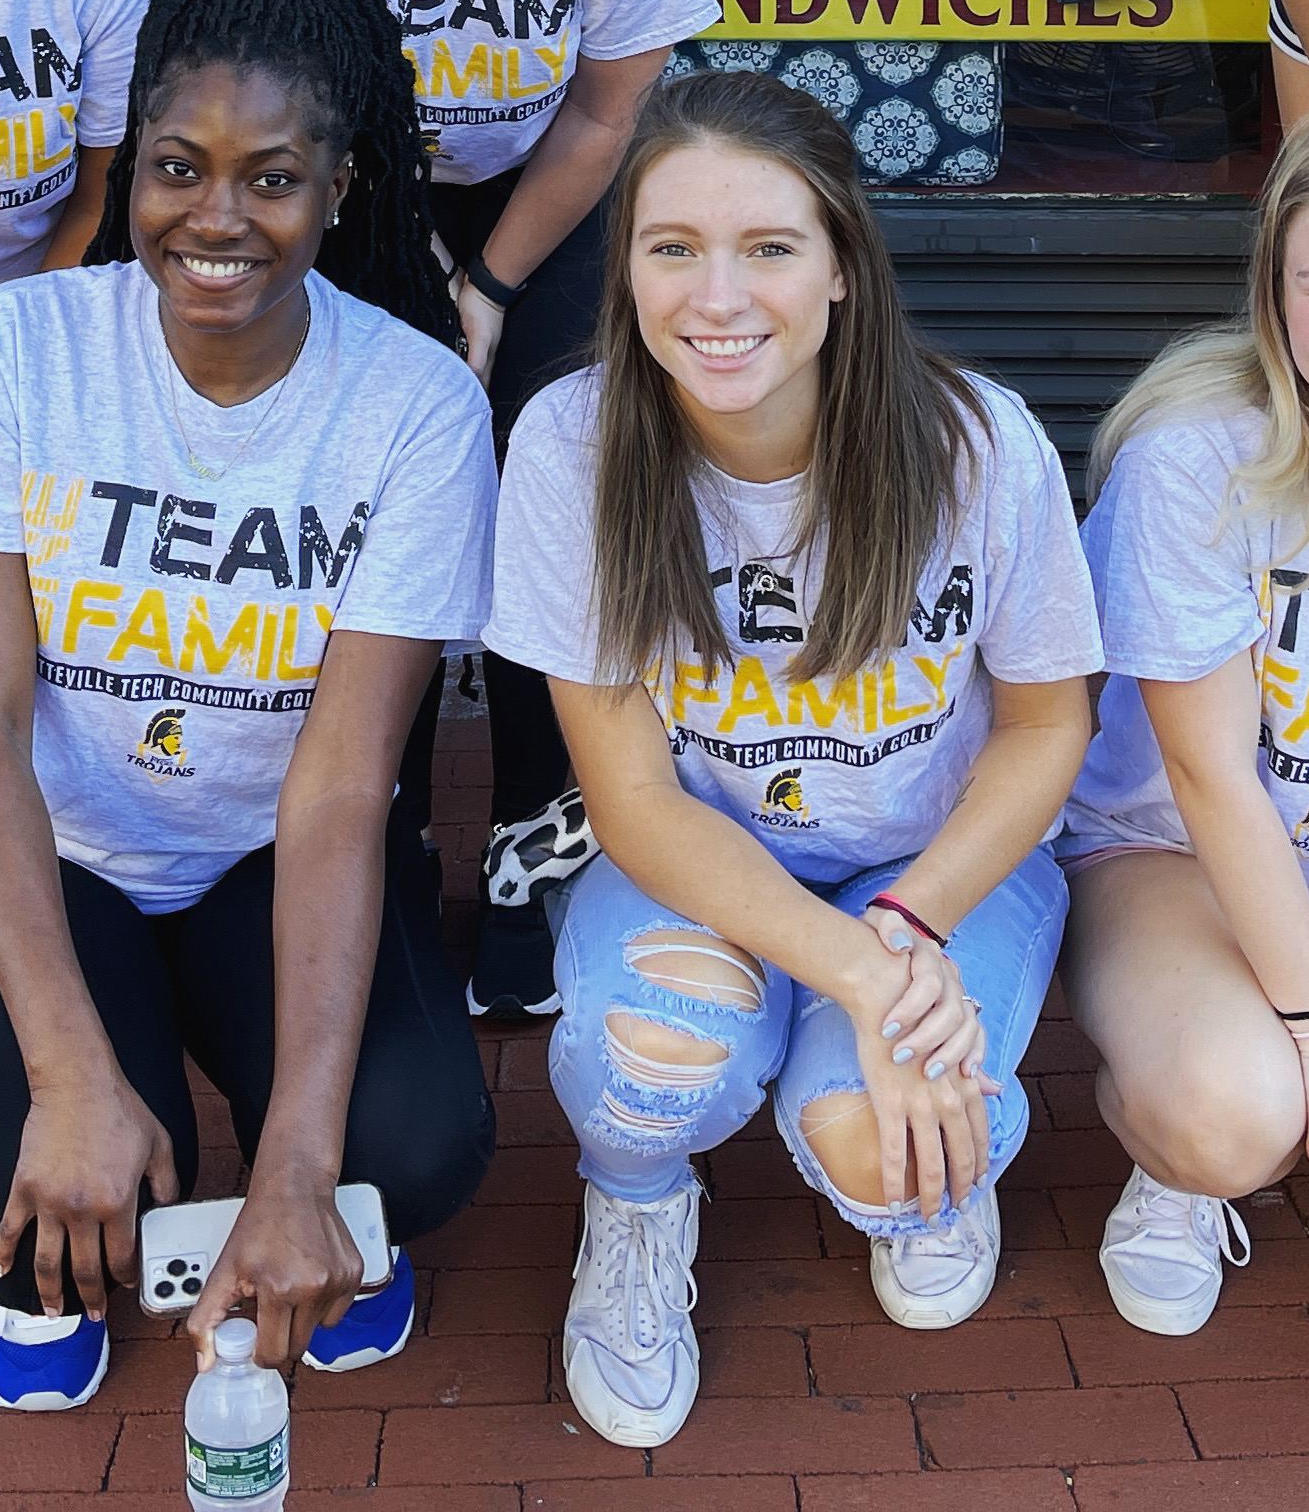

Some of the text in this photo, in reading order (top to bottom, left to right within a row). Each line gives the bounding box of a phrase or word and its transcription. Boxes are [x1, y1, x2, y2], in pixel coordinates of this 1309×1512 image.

[426, 107, 512, 125] COMMUNITY
[91, 480, 371, 591] TEAM
[61, 578, 337, 682] FAMIL
[120, 677, 165, 700] TECH
[169, 680, 277, 711] COMMUNITY
[671, 640, 965, 735] FAMILY
[125, 753, 197, 778] TROJANS
[733, 743, 778, 768] TECH
[782, 740, 885, 766] COMMUNITY
[749, 811, 822, 830] TROJANS
